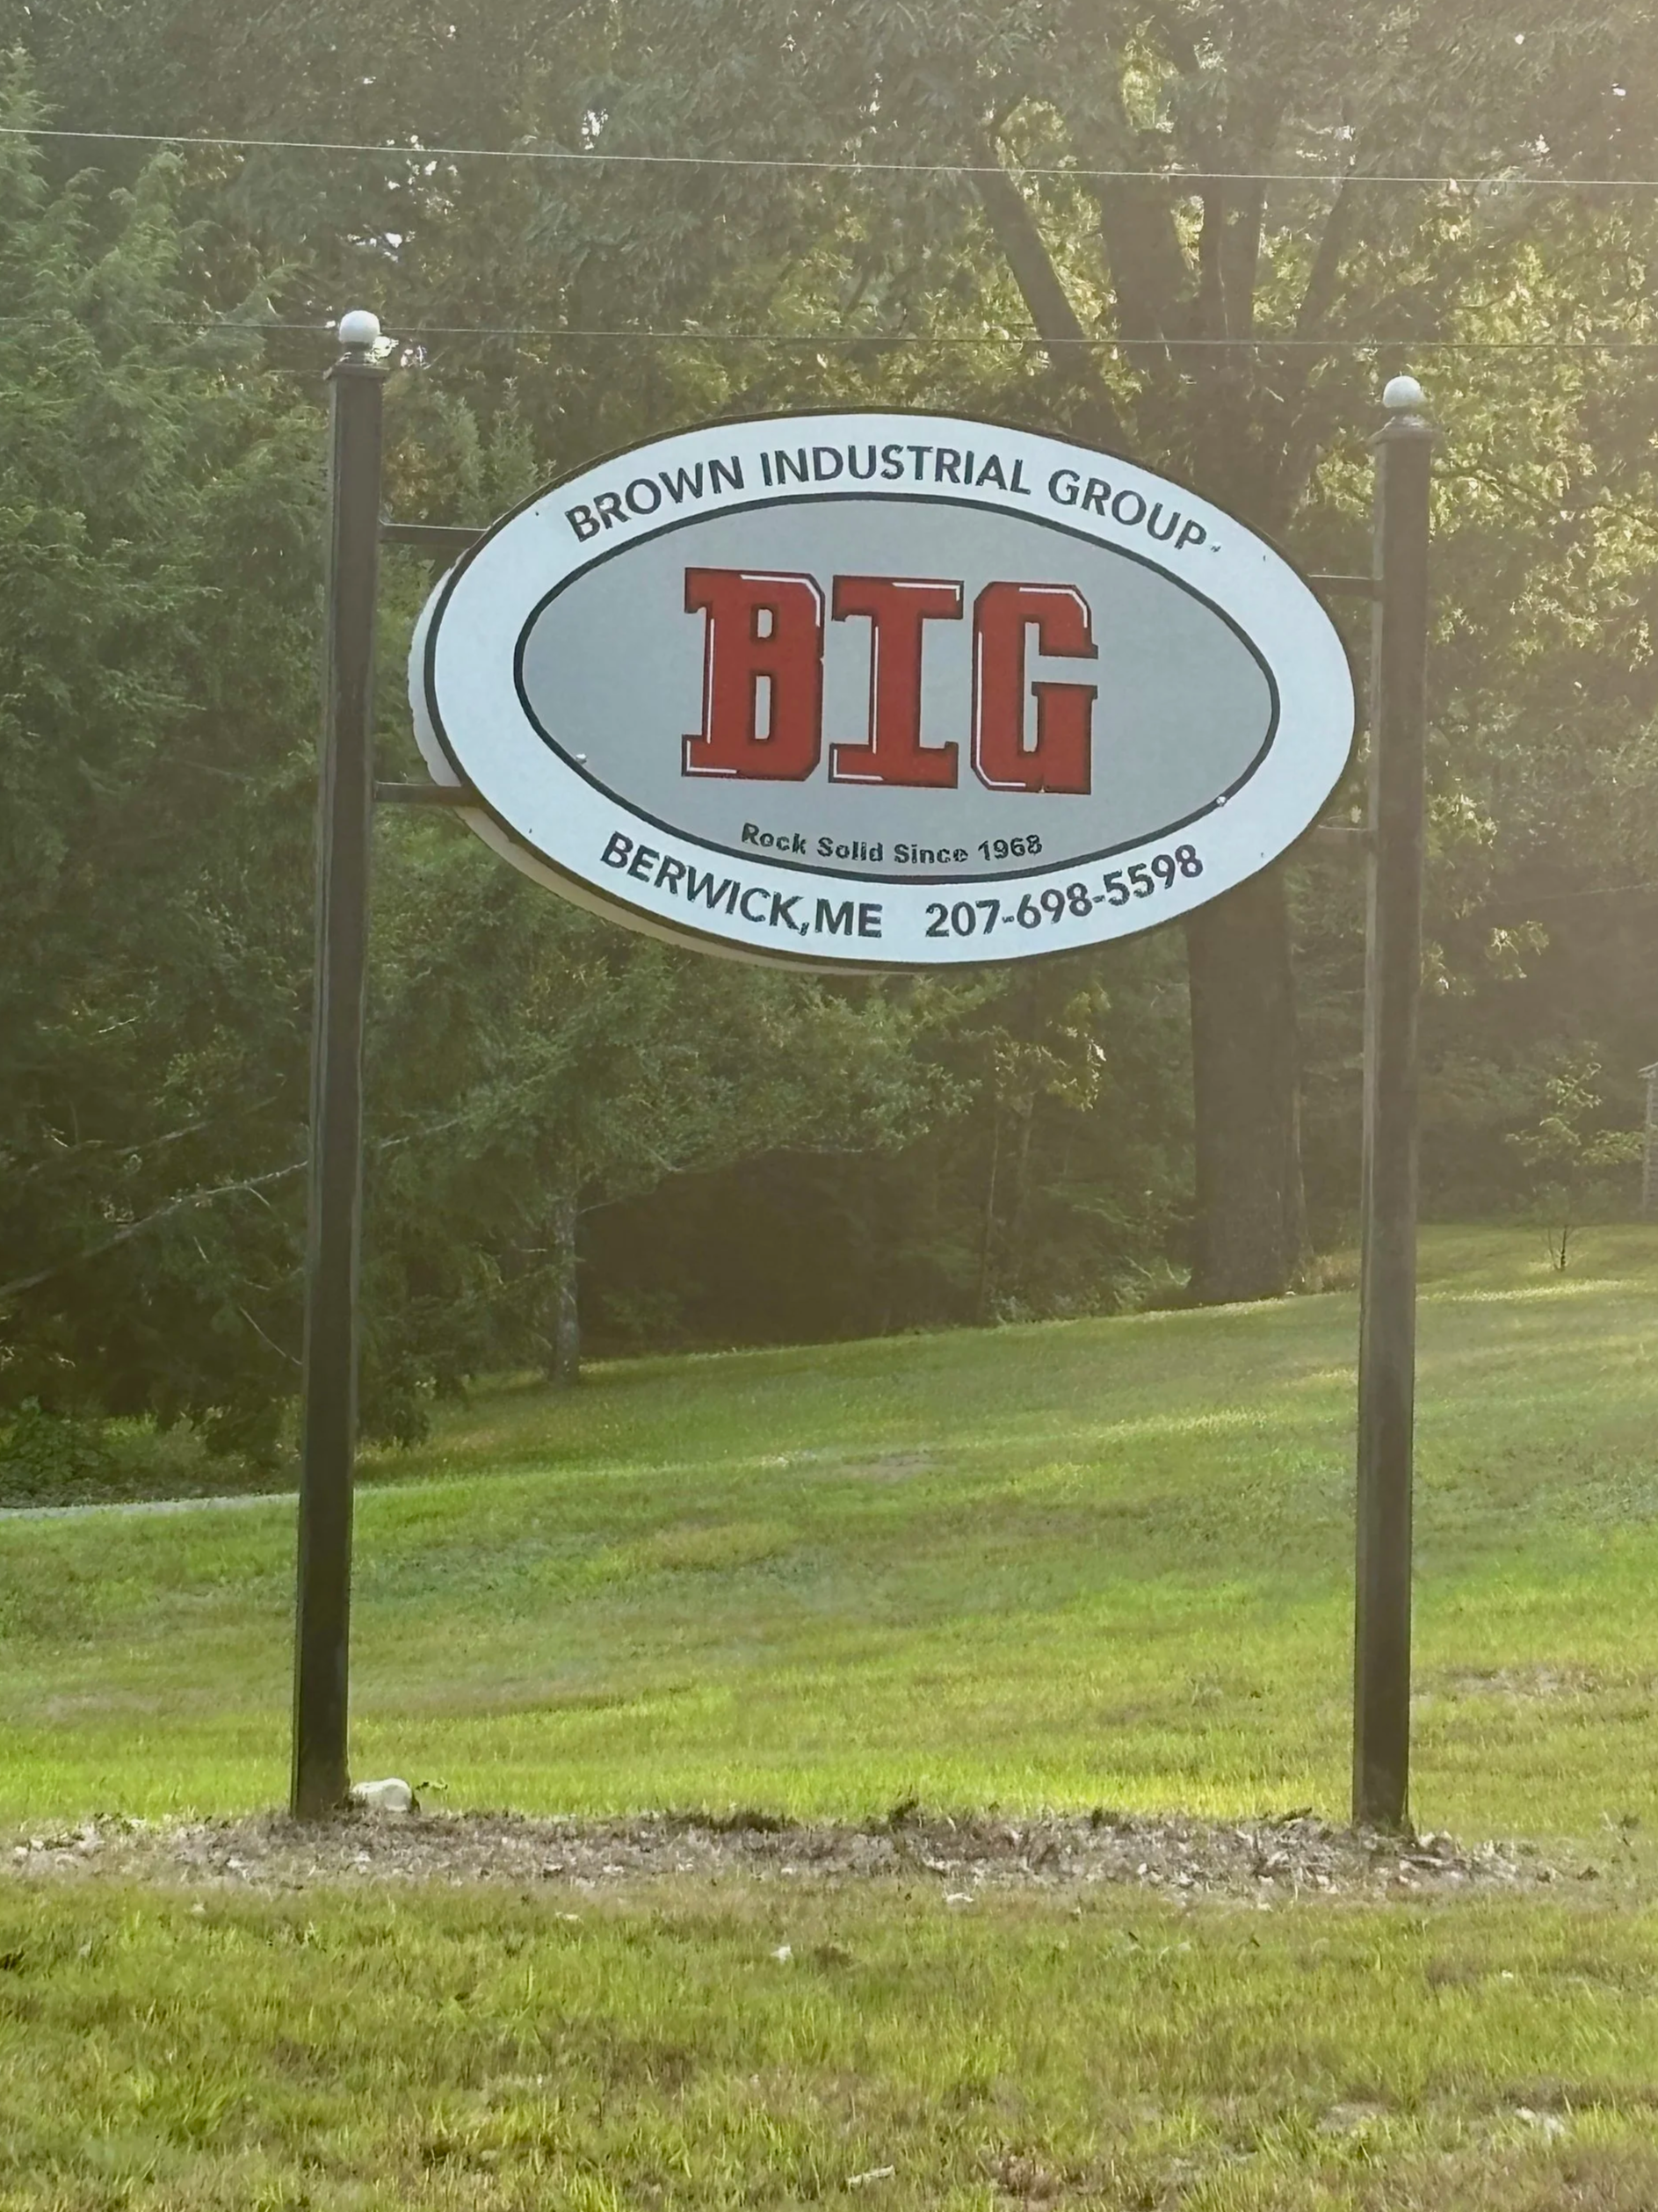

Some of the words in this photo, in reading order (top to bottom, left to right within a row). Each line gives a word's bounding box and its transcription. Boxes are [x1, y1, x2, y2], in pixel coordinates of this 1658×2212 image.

[564, 455, 744, 542] BROWN
[761, 444, 1032, 496] INDUSTRIAL
[681, 567, 1099, 795] BIG
[742, 823, 807, 854] Rock
[817, 837, 883, 862] Solid
[894, 844, 968, 864] Since
[978, 834, 1043, 861] 1968
[925, 845, 1204, 939] 207-698-5598
